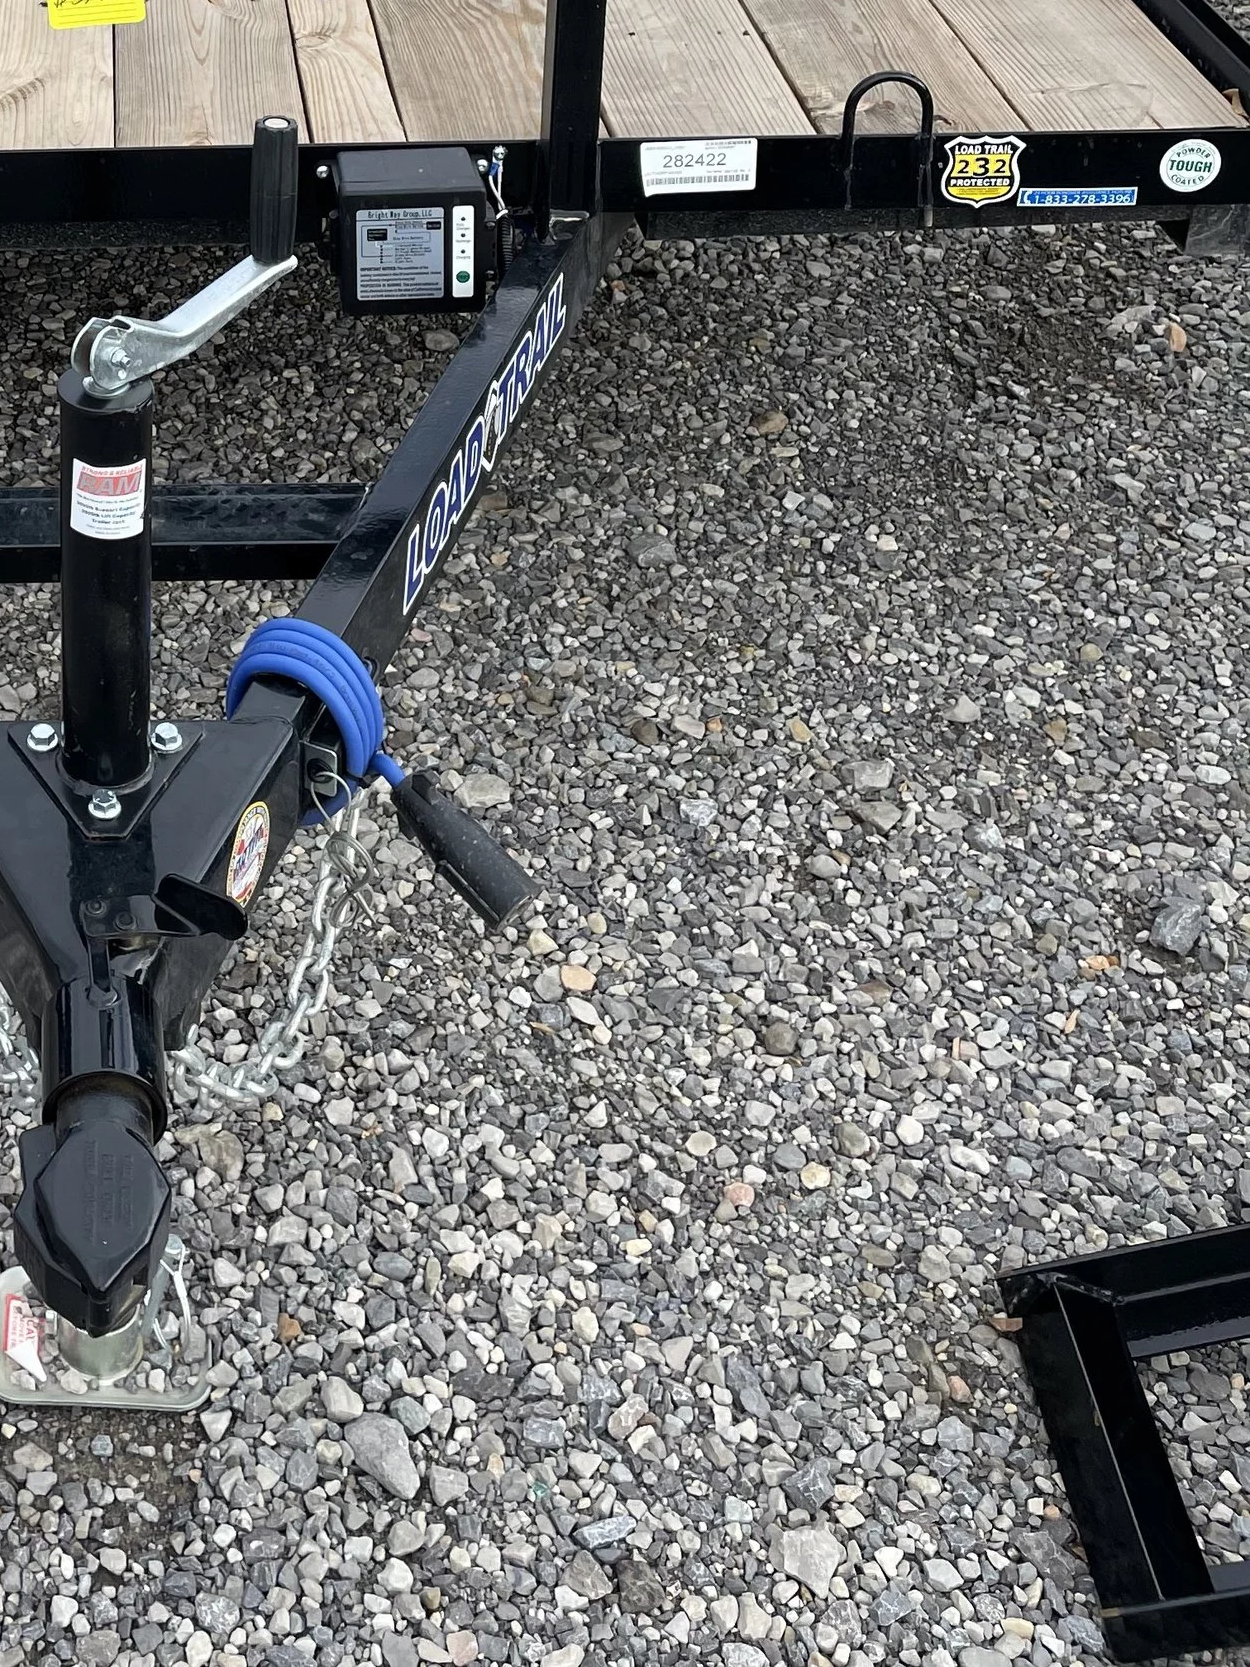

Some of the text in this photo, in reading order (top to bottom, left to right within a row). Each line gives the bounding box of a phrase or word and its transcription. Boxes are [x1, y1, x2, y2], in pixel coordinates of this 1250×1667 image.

[954, 144, 1014, 154] LOAD TRAIL
[1176, 147, 1211, 159] POWDER
[663, 152, 727, 168] 282422
[957, 157, 1007, 176] 232
[1169, 159, 1213, 173] TOUGH
[950, 178, 1010, 187] PROTECTED
[1171, 174, 1204, 185] COATED
[1034, 194, 1131, 204] 1-833-278-3396
[403, 272, 567, 615] LOAD TRAIL
[78, 472, 141, 495] RAM
